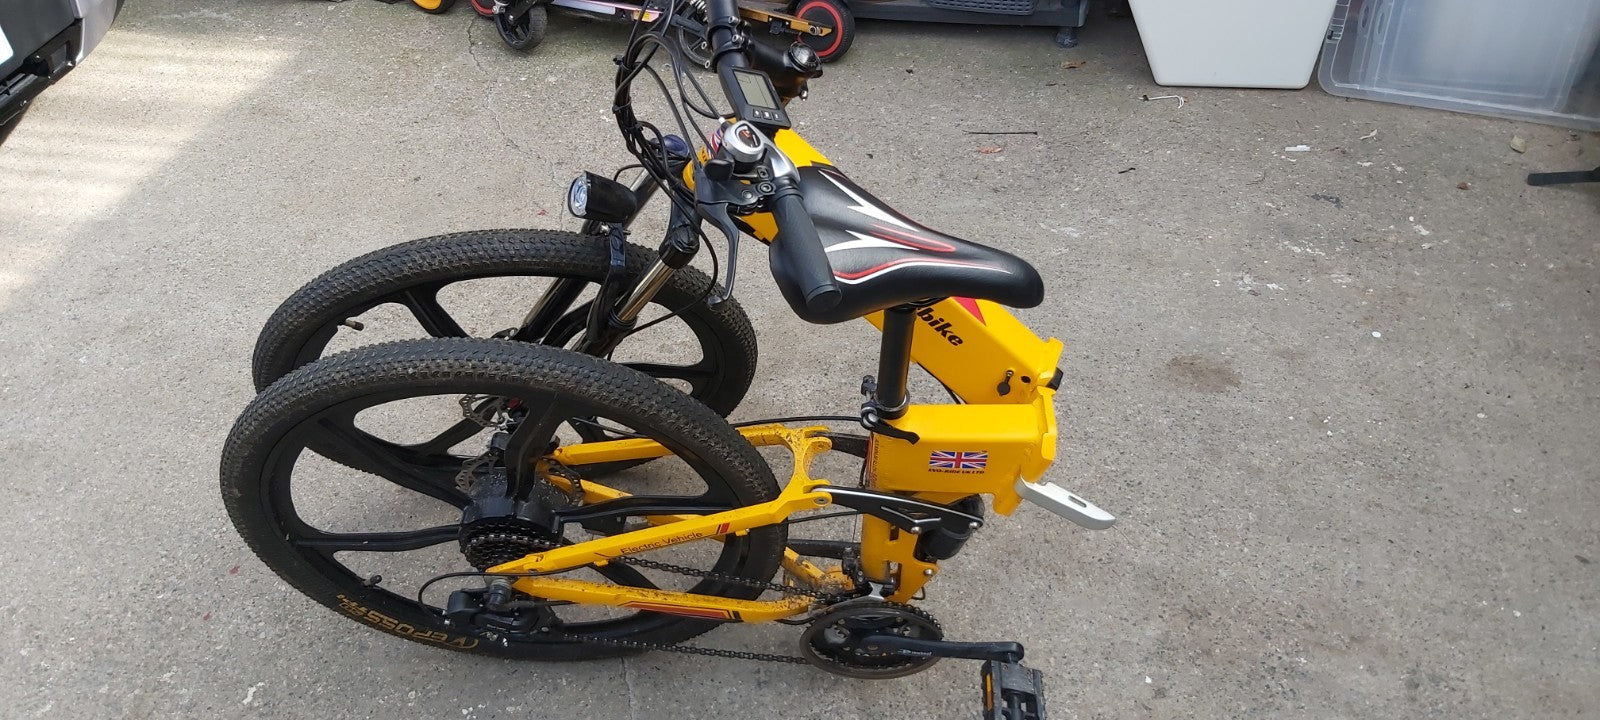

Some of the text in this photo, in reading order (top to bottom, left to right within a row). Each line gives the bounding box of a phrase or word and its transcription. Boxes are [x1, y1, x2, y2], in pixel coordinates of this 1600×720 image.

[917, 307, 964, 346] bike
[620, 531, 703, 554] Electric Vehicle
